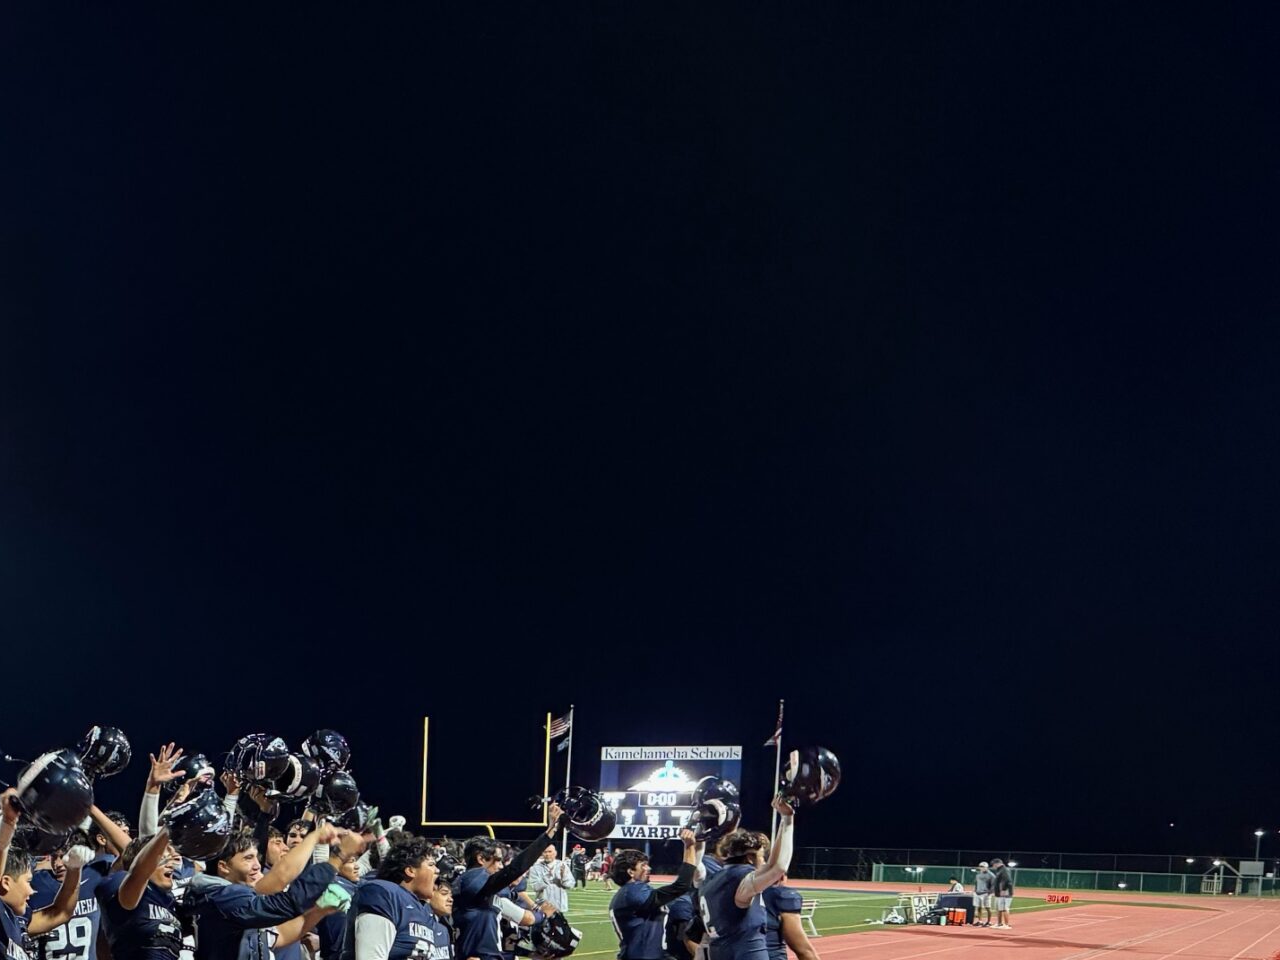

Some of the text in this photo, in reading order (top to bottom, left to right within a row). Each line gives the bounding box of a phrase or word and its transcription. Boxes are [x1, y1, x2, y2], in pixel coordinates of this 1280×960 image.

[604, 747, 740, 759] Kamehameha Schools
[621, 826, 678, 838] WARRI
